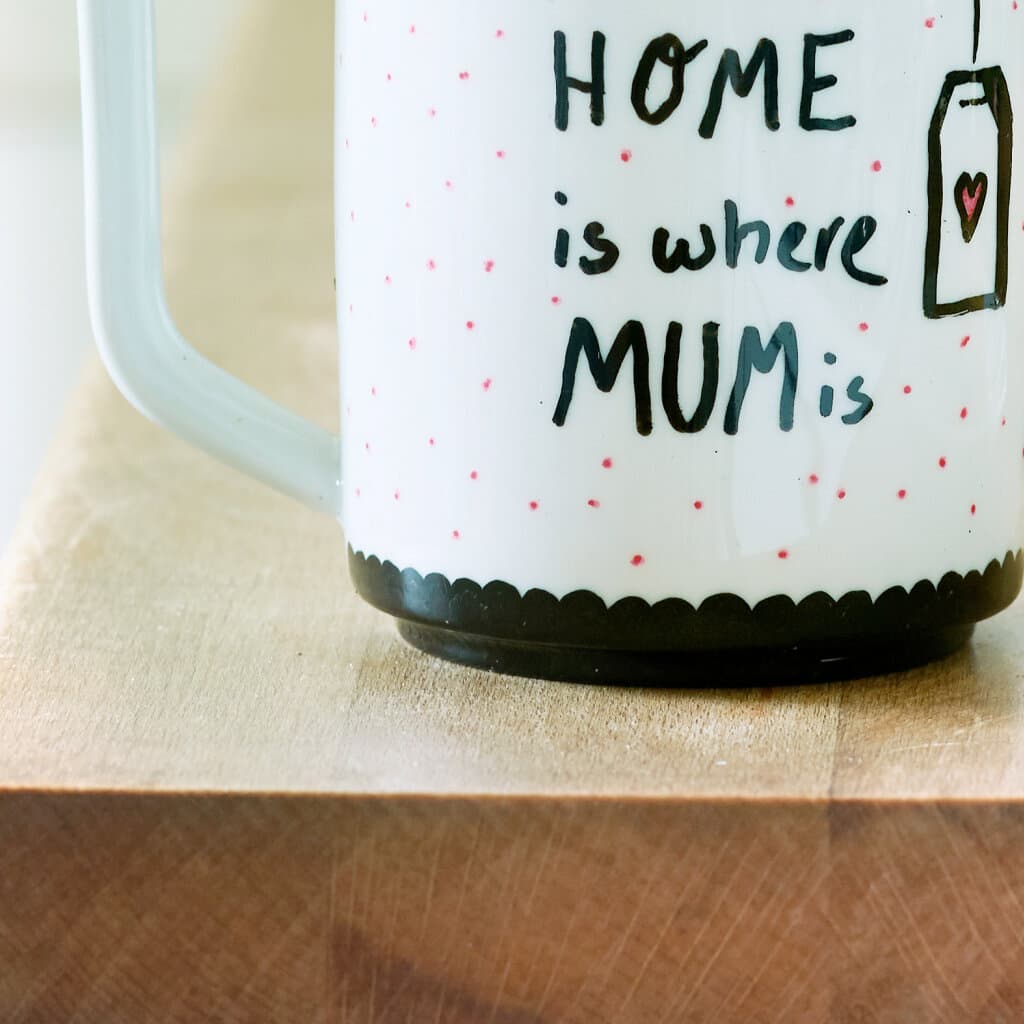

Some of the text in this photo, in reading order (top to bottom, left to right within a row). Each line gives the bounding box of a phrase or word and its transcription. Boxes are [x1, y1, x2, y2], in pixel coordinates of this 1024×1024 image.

[553, 29, 856, 139] HOME
[554, 190, 889, 286] is where
[552, 316, 874, 436] MUM is
